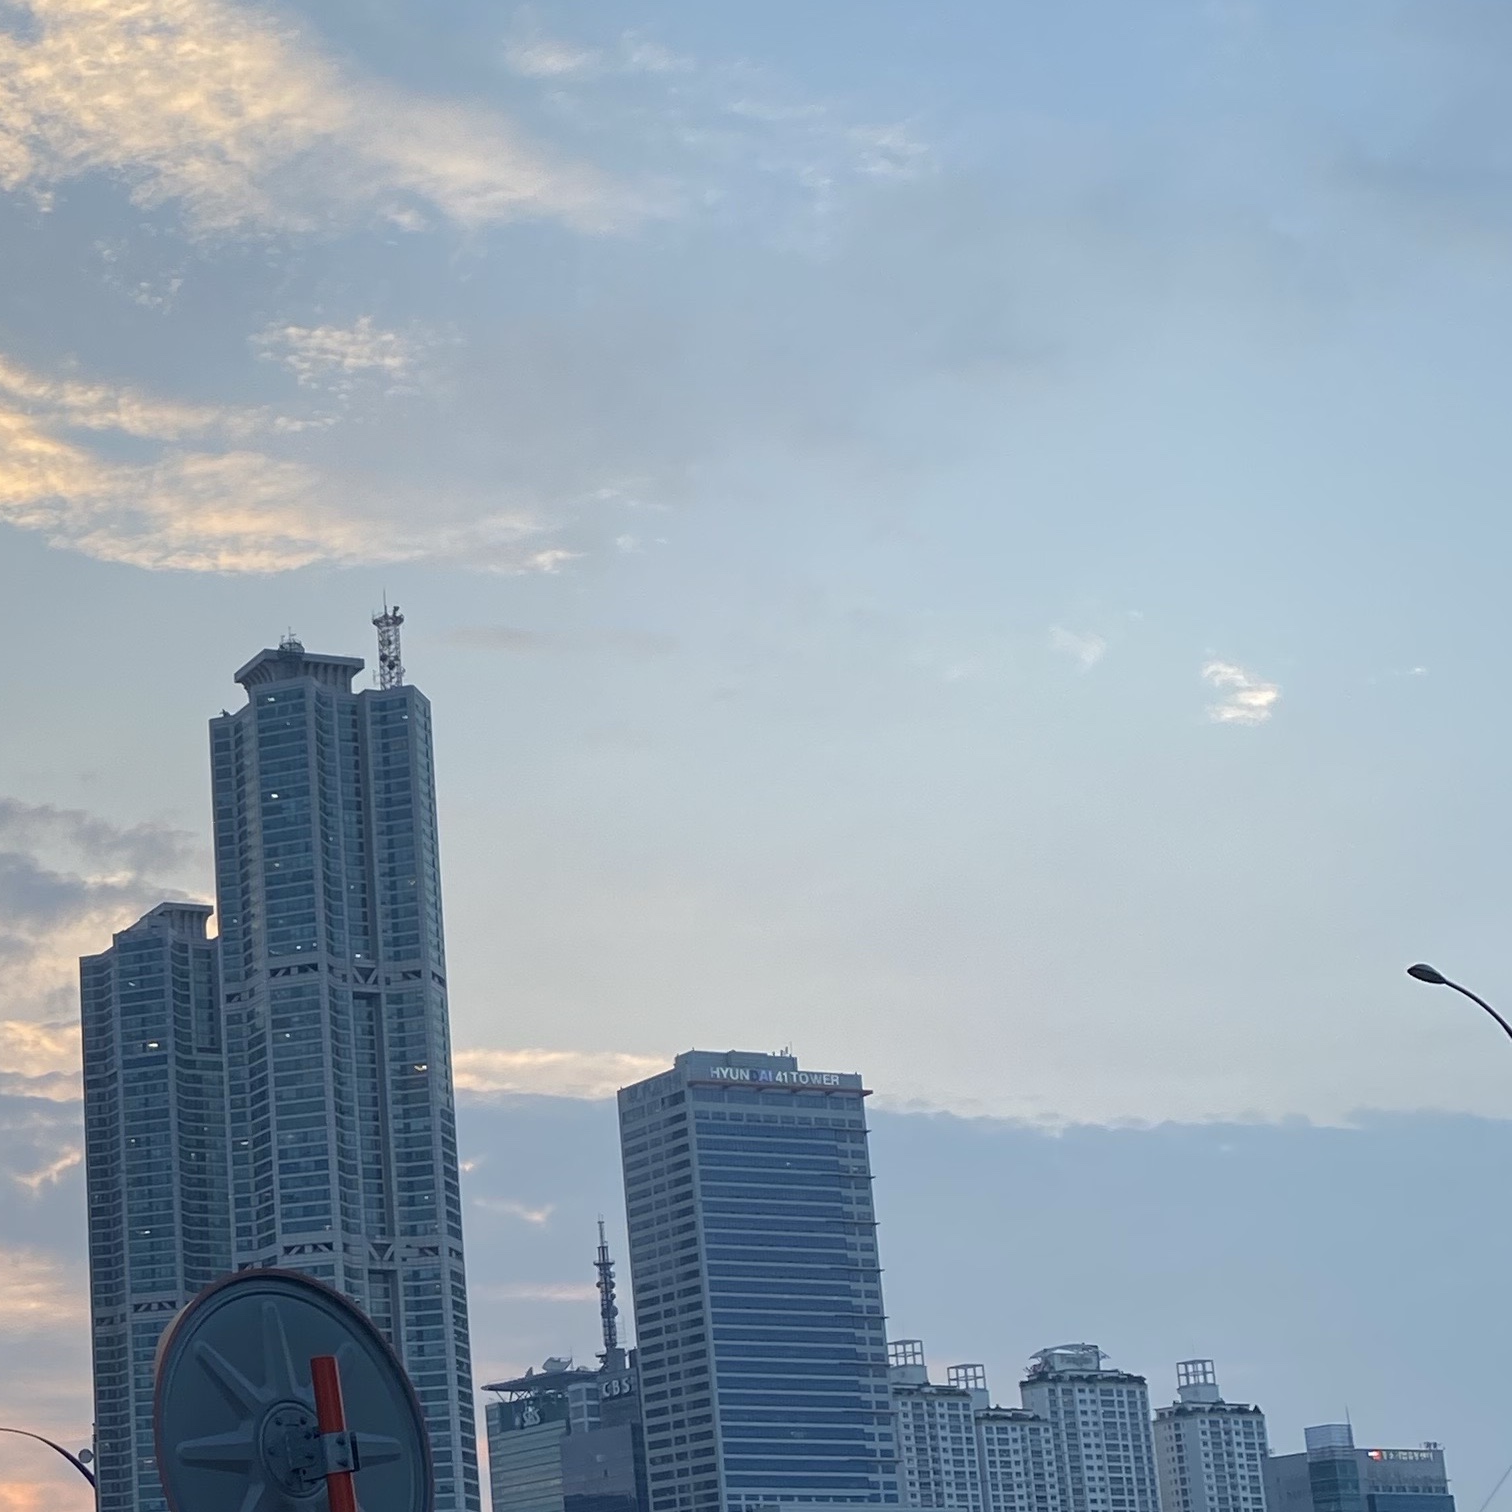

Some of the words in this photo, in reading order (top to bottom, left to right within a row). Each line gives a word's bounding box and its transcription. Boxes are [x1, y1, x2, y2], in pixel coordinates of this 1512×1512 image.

[710, 1067, 773, 1082] HYUNDAI
[775, 1071, 788, 1083] 41
[790, 1071, 840, 1086] TOWER
[602, 1378, 631, 1397] CBS
